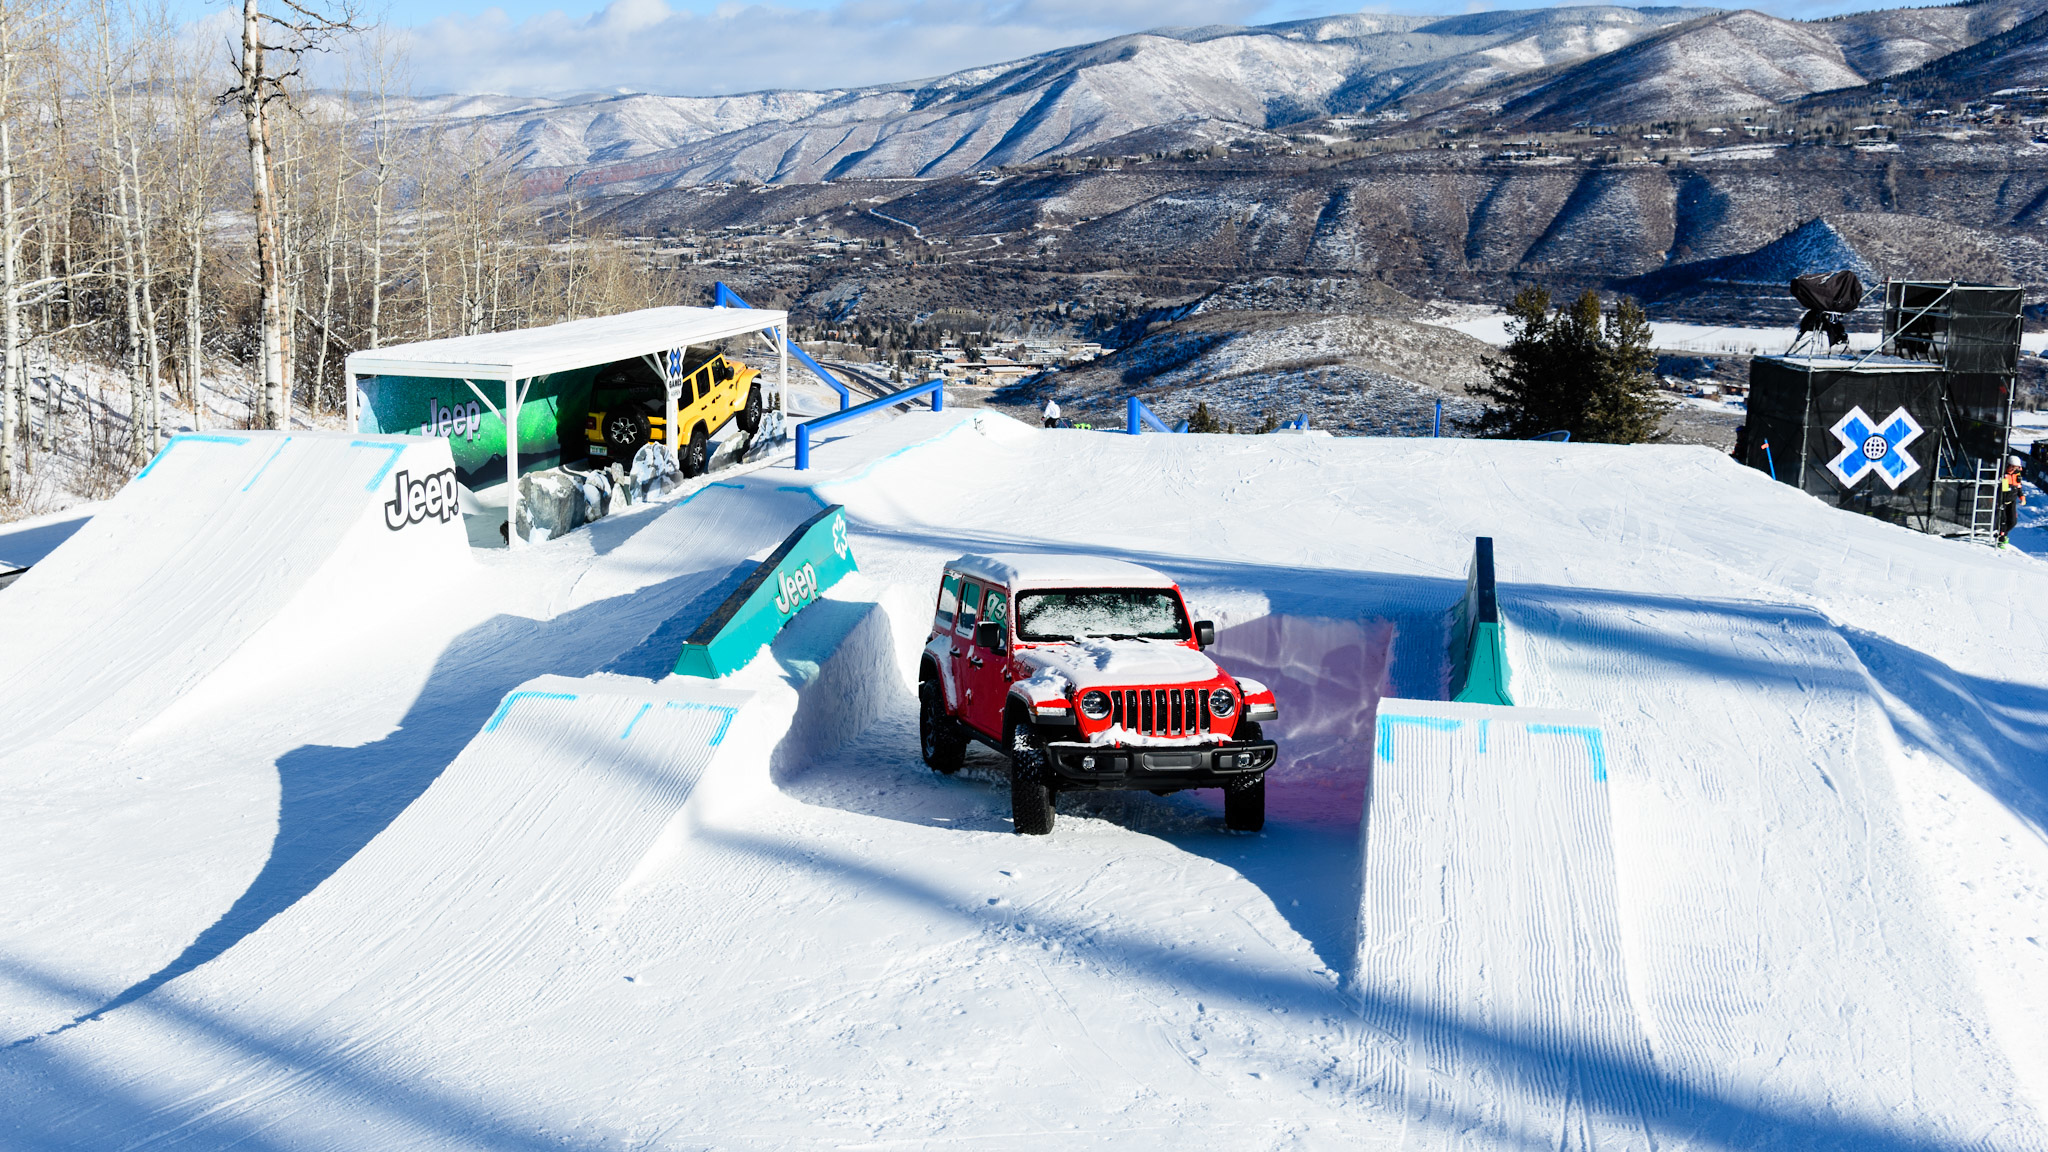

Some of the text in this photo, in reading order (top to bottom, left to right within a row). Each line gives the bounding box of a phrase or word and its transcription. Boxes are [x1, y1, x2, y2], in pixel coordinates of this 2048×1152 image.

[421, 397, 481, 442] Jeep
[384, 467, 459, 531] Jeep
[774, 561, 818, 615] Jeep
